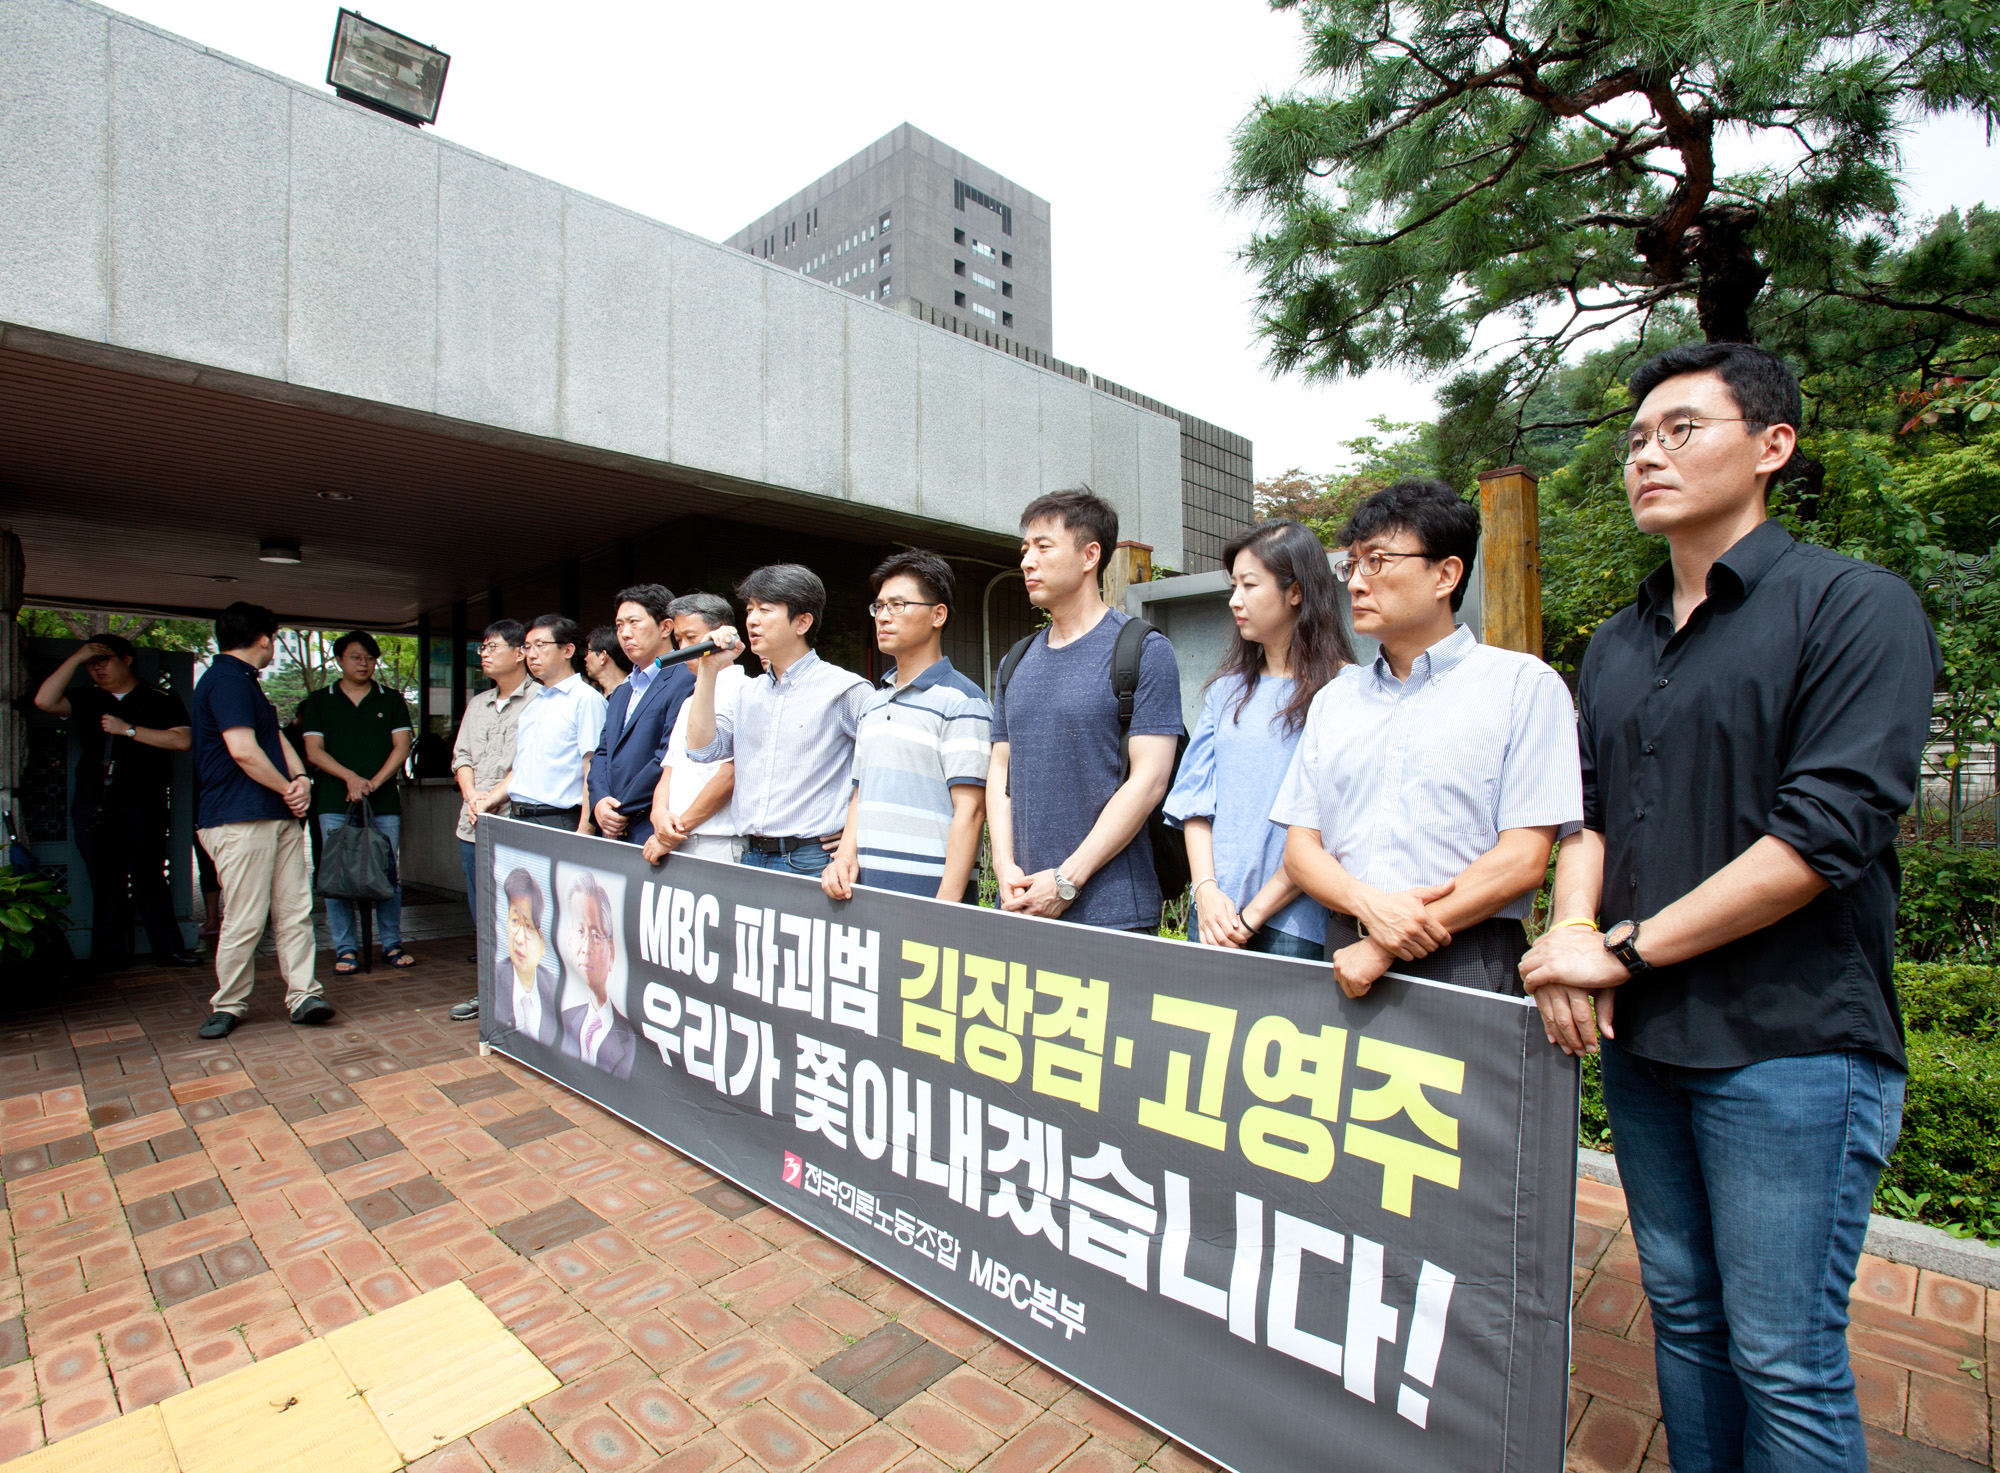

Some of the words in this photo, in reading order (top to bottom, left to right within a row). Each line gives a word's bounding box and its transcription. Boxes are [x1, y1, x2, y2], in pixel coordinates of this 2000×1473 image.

[641, 881, 719, 983] MBC
[733, 905, 880, 1037] 파괴범
[642, 982, 781, 1116] 우리가
[795, 1033, 1456, 1429] 쫓아내겠습니다!
[804, 1162, 961, 1271] 전국언론노동조합
[969, 1249, 1086, 1340] MBC본부
